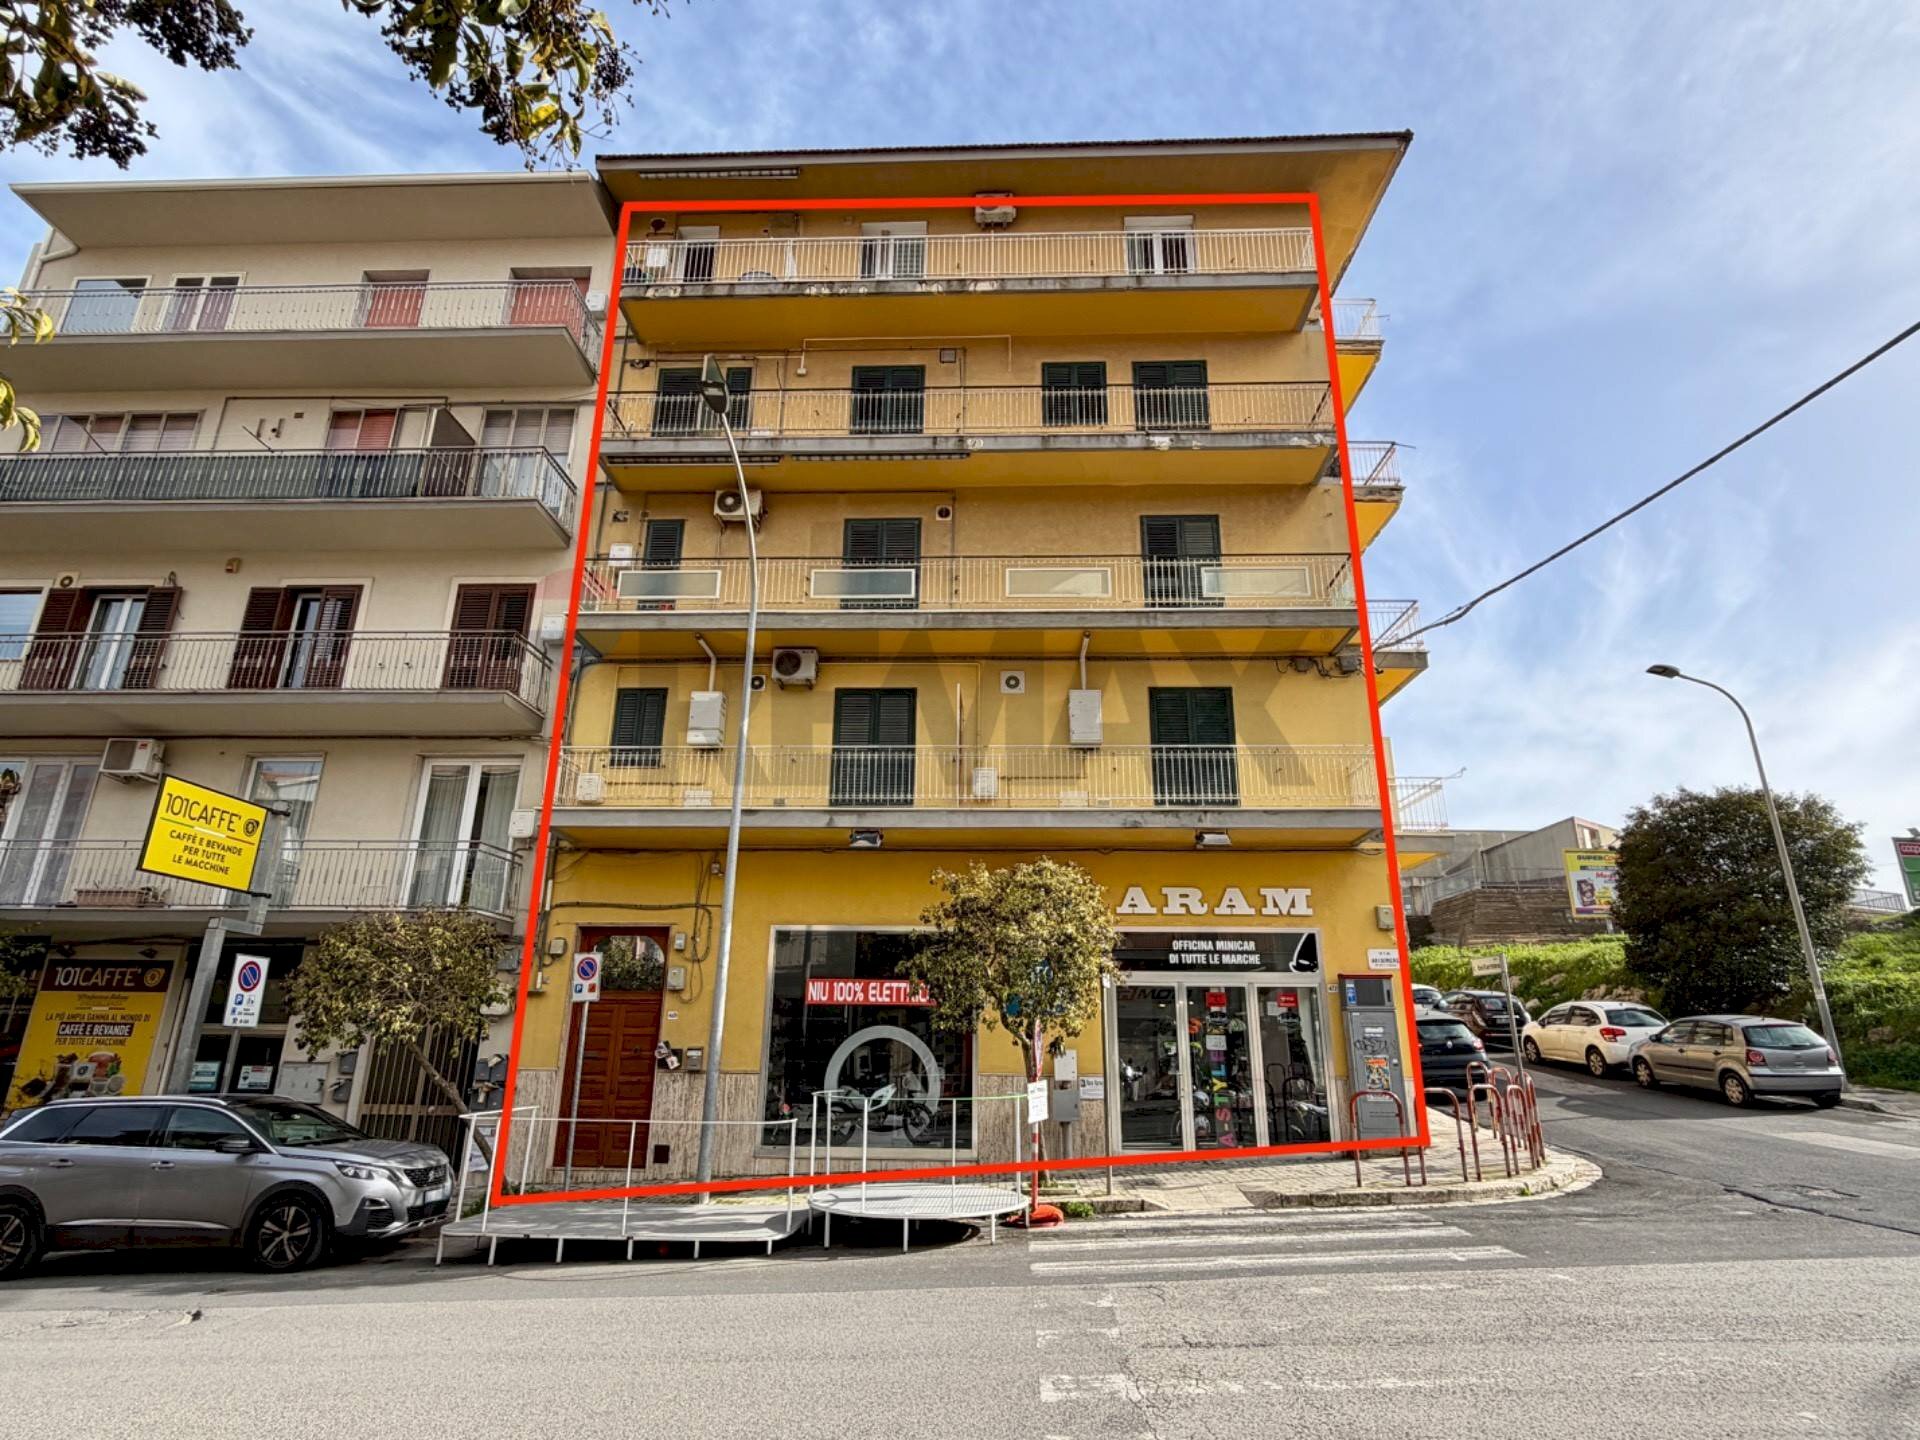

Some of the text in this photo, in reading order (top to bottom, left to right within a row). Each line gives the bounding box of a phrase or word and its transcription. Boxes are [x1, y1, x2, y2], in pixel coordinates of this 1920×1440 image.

[182, 845, 225, 862] PER TUTTE
[206, 840, 243, 856] BEVANDE
[173, 854, 230, 874] LE MACCHINE
[1115, 886, 1314, 917] ARAM
[1172, 939, 1257, 951] OFFICINA MINICAR
[1169, 953, 1261, 965] DI TUTTE LE MARCHE
[808, 982, 829, 1001] NIU
[833, 982, 864, 1001] 100%
[93, 1025, 131, 1036] BEVANDE
